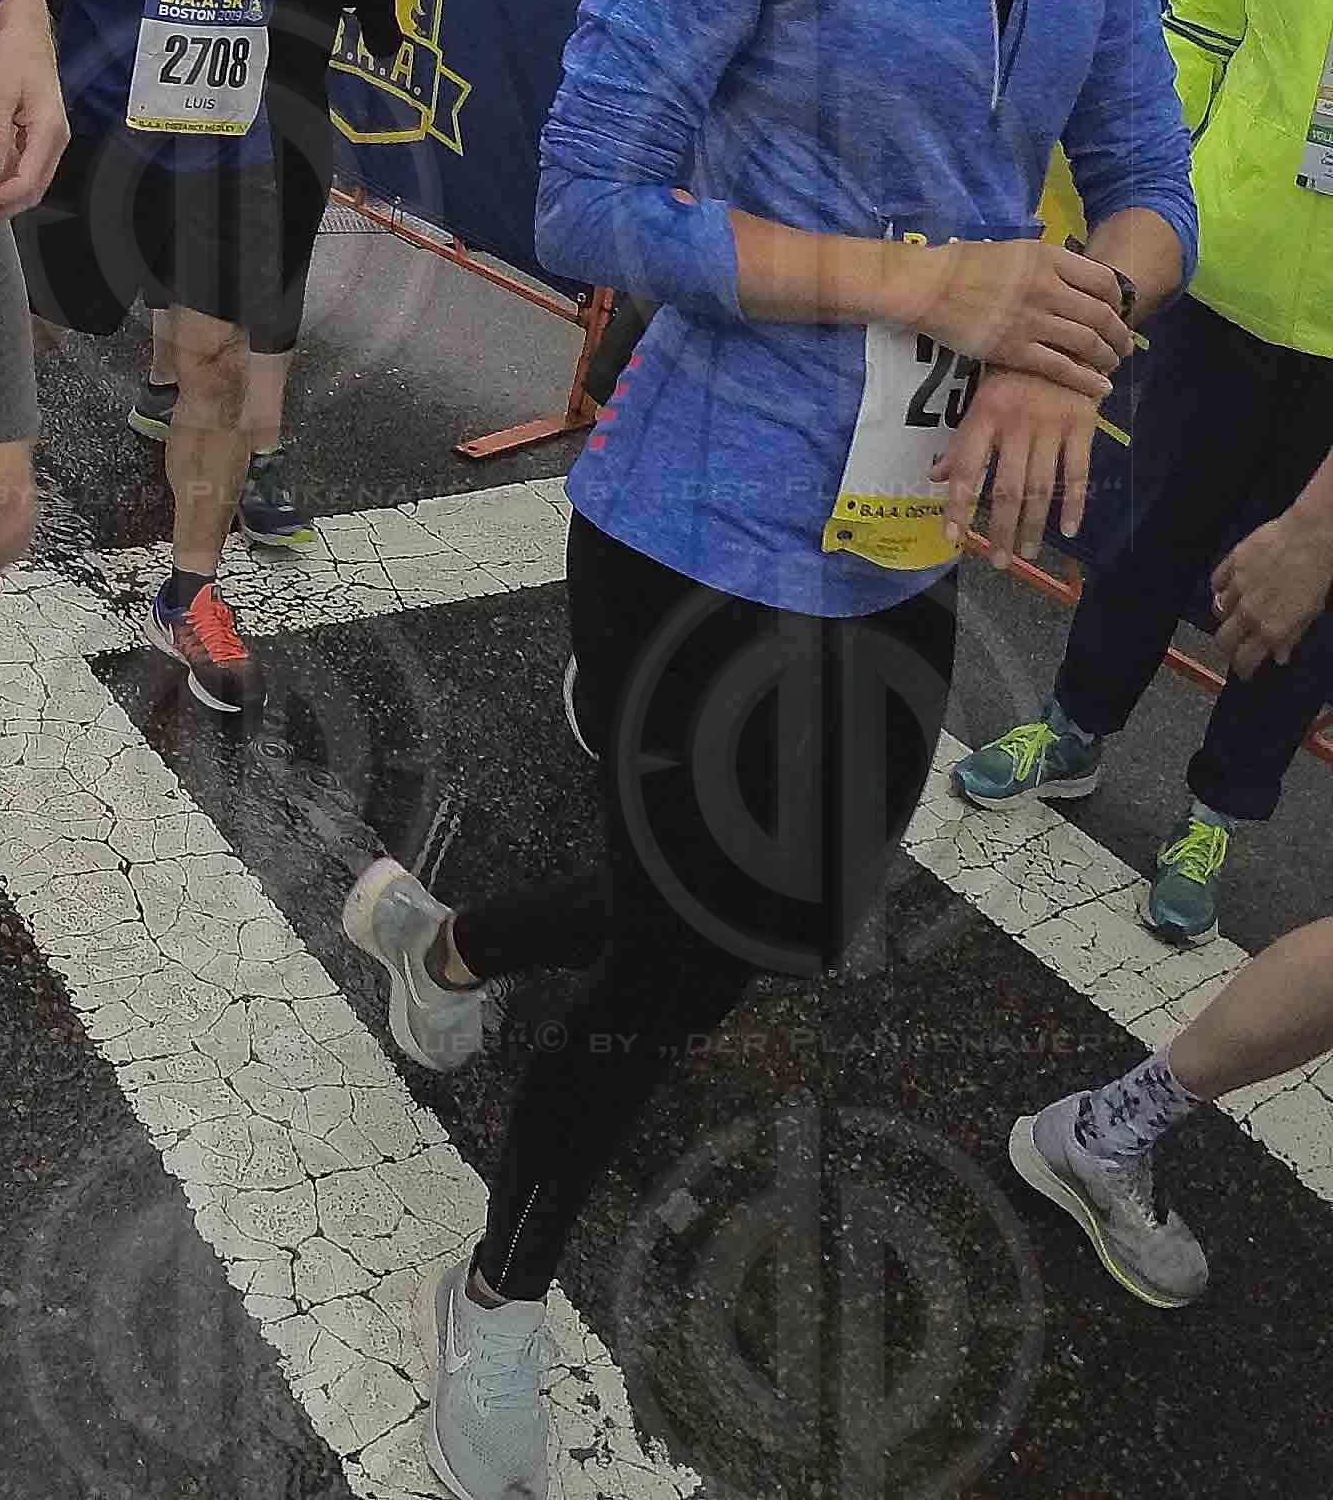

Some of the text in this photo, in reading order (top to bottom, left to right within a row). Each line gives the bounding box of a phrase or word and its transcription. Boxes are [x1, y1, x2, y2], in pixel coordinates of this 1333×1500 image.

[157, 3, 216, 21] BOSTON
[159, 33, 251, 89] 2708
[184, 98, 216, 110] LUIS
